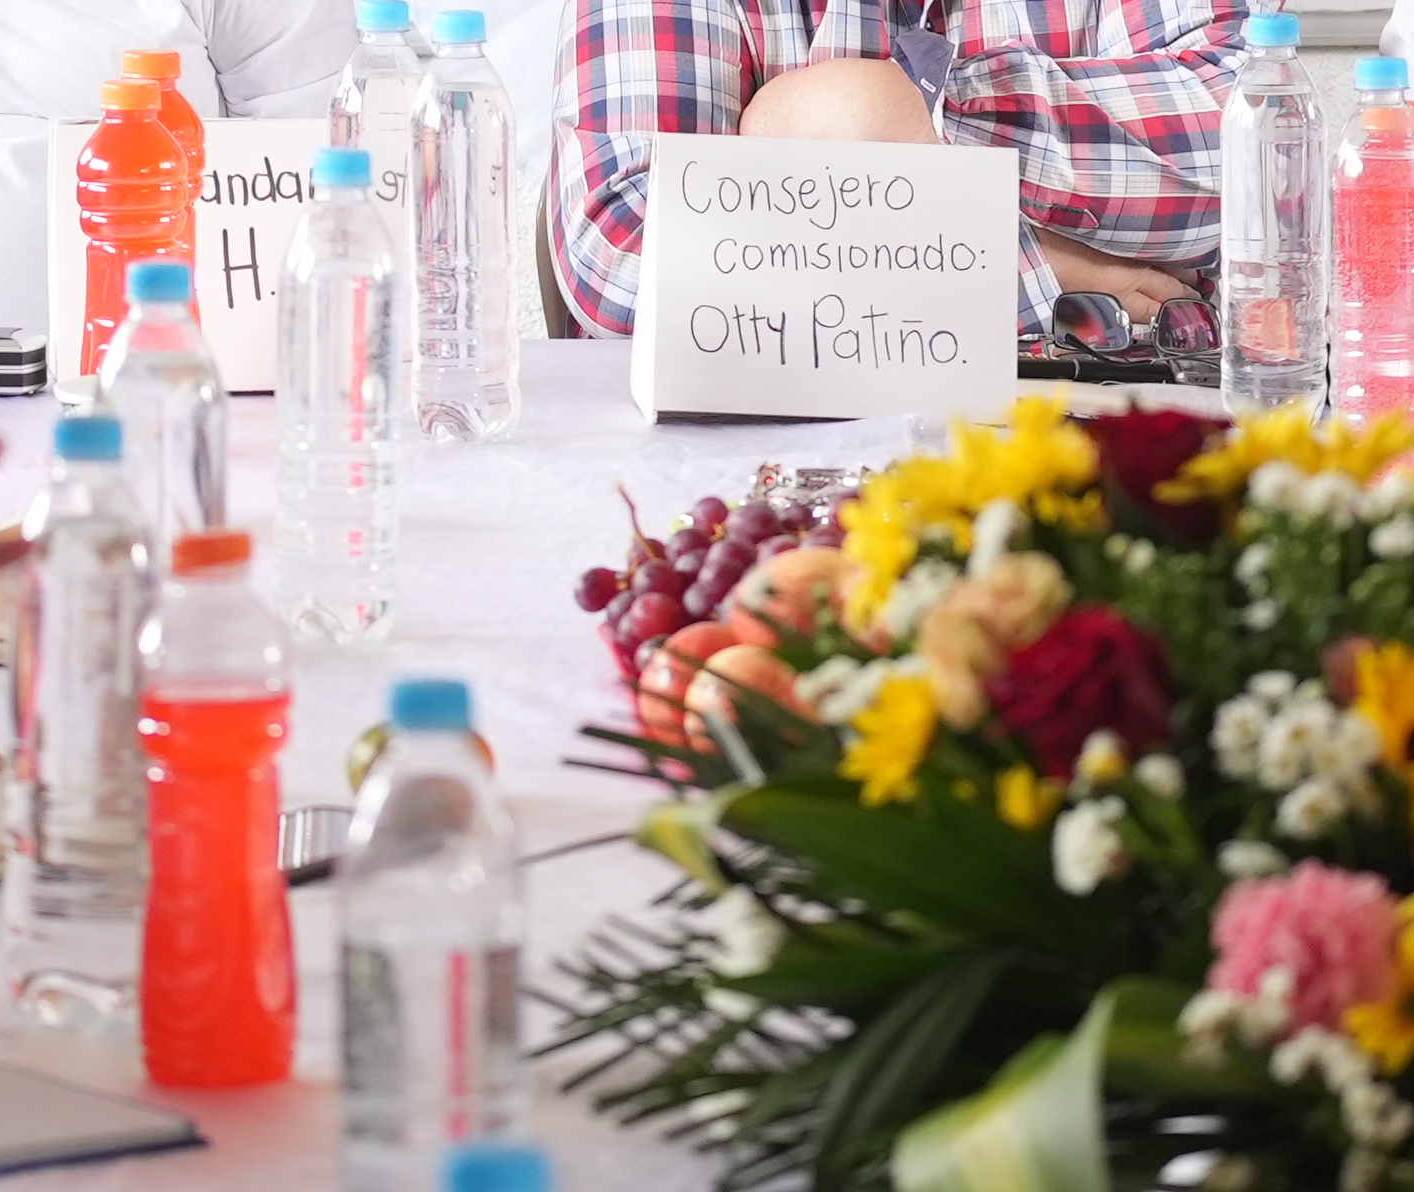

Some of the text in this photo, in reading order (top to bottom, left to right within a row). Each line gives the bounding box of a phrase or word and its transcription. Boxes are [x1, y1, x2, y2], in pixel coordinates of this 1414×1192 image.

[681, 160, 916, 230] Consejero
[222, 226, 276, 310] H.
[714, 233, 989, 275] comisionado:
[690, 293, 968, 370] Otty Patiño.
